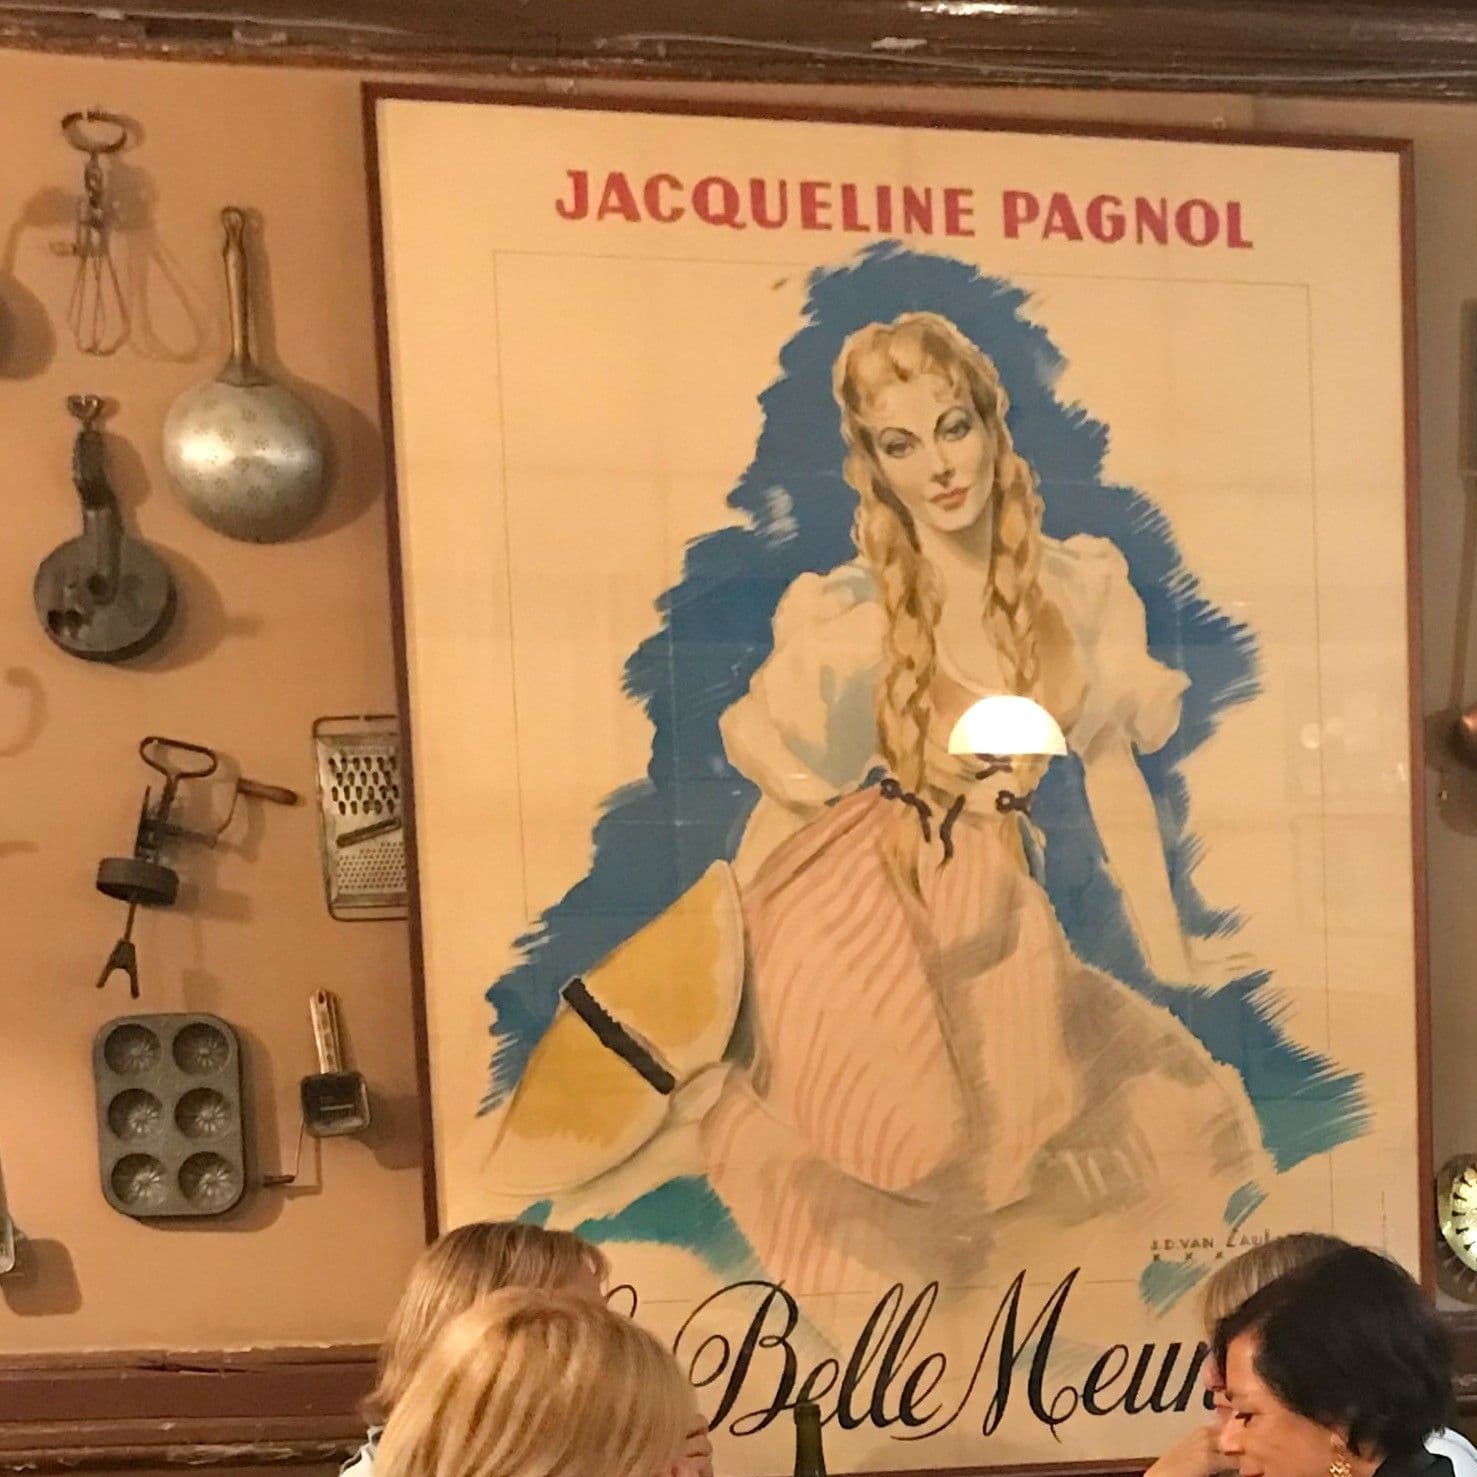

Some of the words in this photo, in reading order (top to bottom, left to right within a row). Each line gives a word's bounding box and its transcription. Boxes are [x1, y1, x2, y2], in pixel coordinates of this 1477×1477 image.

[555, 168, 976, 237] JACQUELINE
[1001, 189, 1254, 250] PAGNOL
[673, 1279, 947, 1438] Belle
